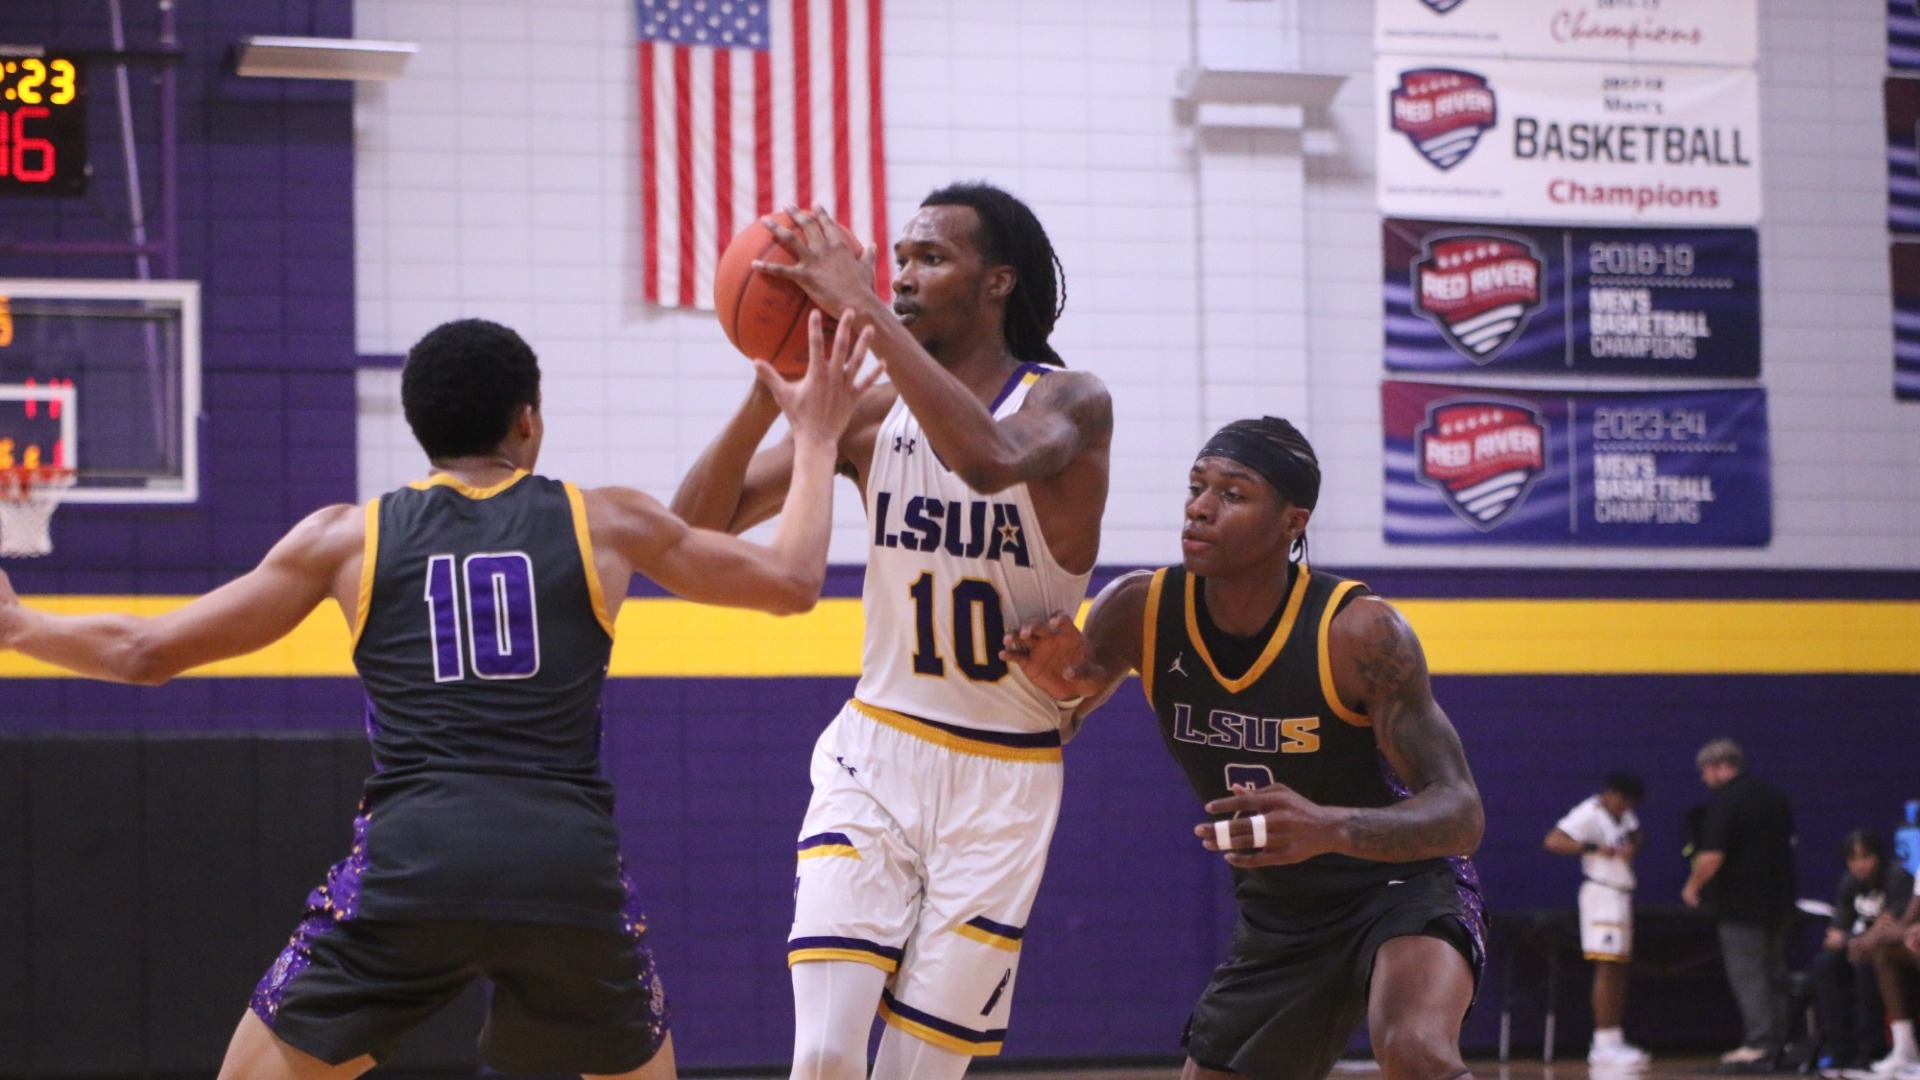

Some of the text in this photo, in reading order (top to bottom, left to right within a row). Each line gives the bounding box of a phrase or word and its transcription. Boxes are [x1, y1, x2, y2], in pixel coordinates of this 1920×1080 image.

[0, 58, 76, 105] :23
[1394, 87, 1493, 123] RED RIVER
[1513, 117, 1751, 167] BASKETBALL
[1547, 179, 1720, 212] Champions
[1589, 242, 1695, 276] 2018-19
[1421, 271, 1469, 301] RED
[1470, 258, 1538, 296] RIVER
[1589, 287, 1652, 314] MEN'S
[1590, 311, 1712, 338] BASKETBALL
[1590, 336, 1697, 360] CHAMPIONS
[1593, 407, 1707, 441] 2023-24
[1426, 437, 1472, 468] RED
[1474, 424, 1540, 463] RIVER
[1594, 453, 1656, 480] MEN'S
[1594, 475, 1716, 503] BASKETBALL
[875, 491, 1030, 568] LSUA
[1594, 501, 1700, 525] CHAMPIONS
[424, 551, 541, 683] 10
[909, 569, 1010, 684] 10
[1173, 702, 1321, 753] LSUS
